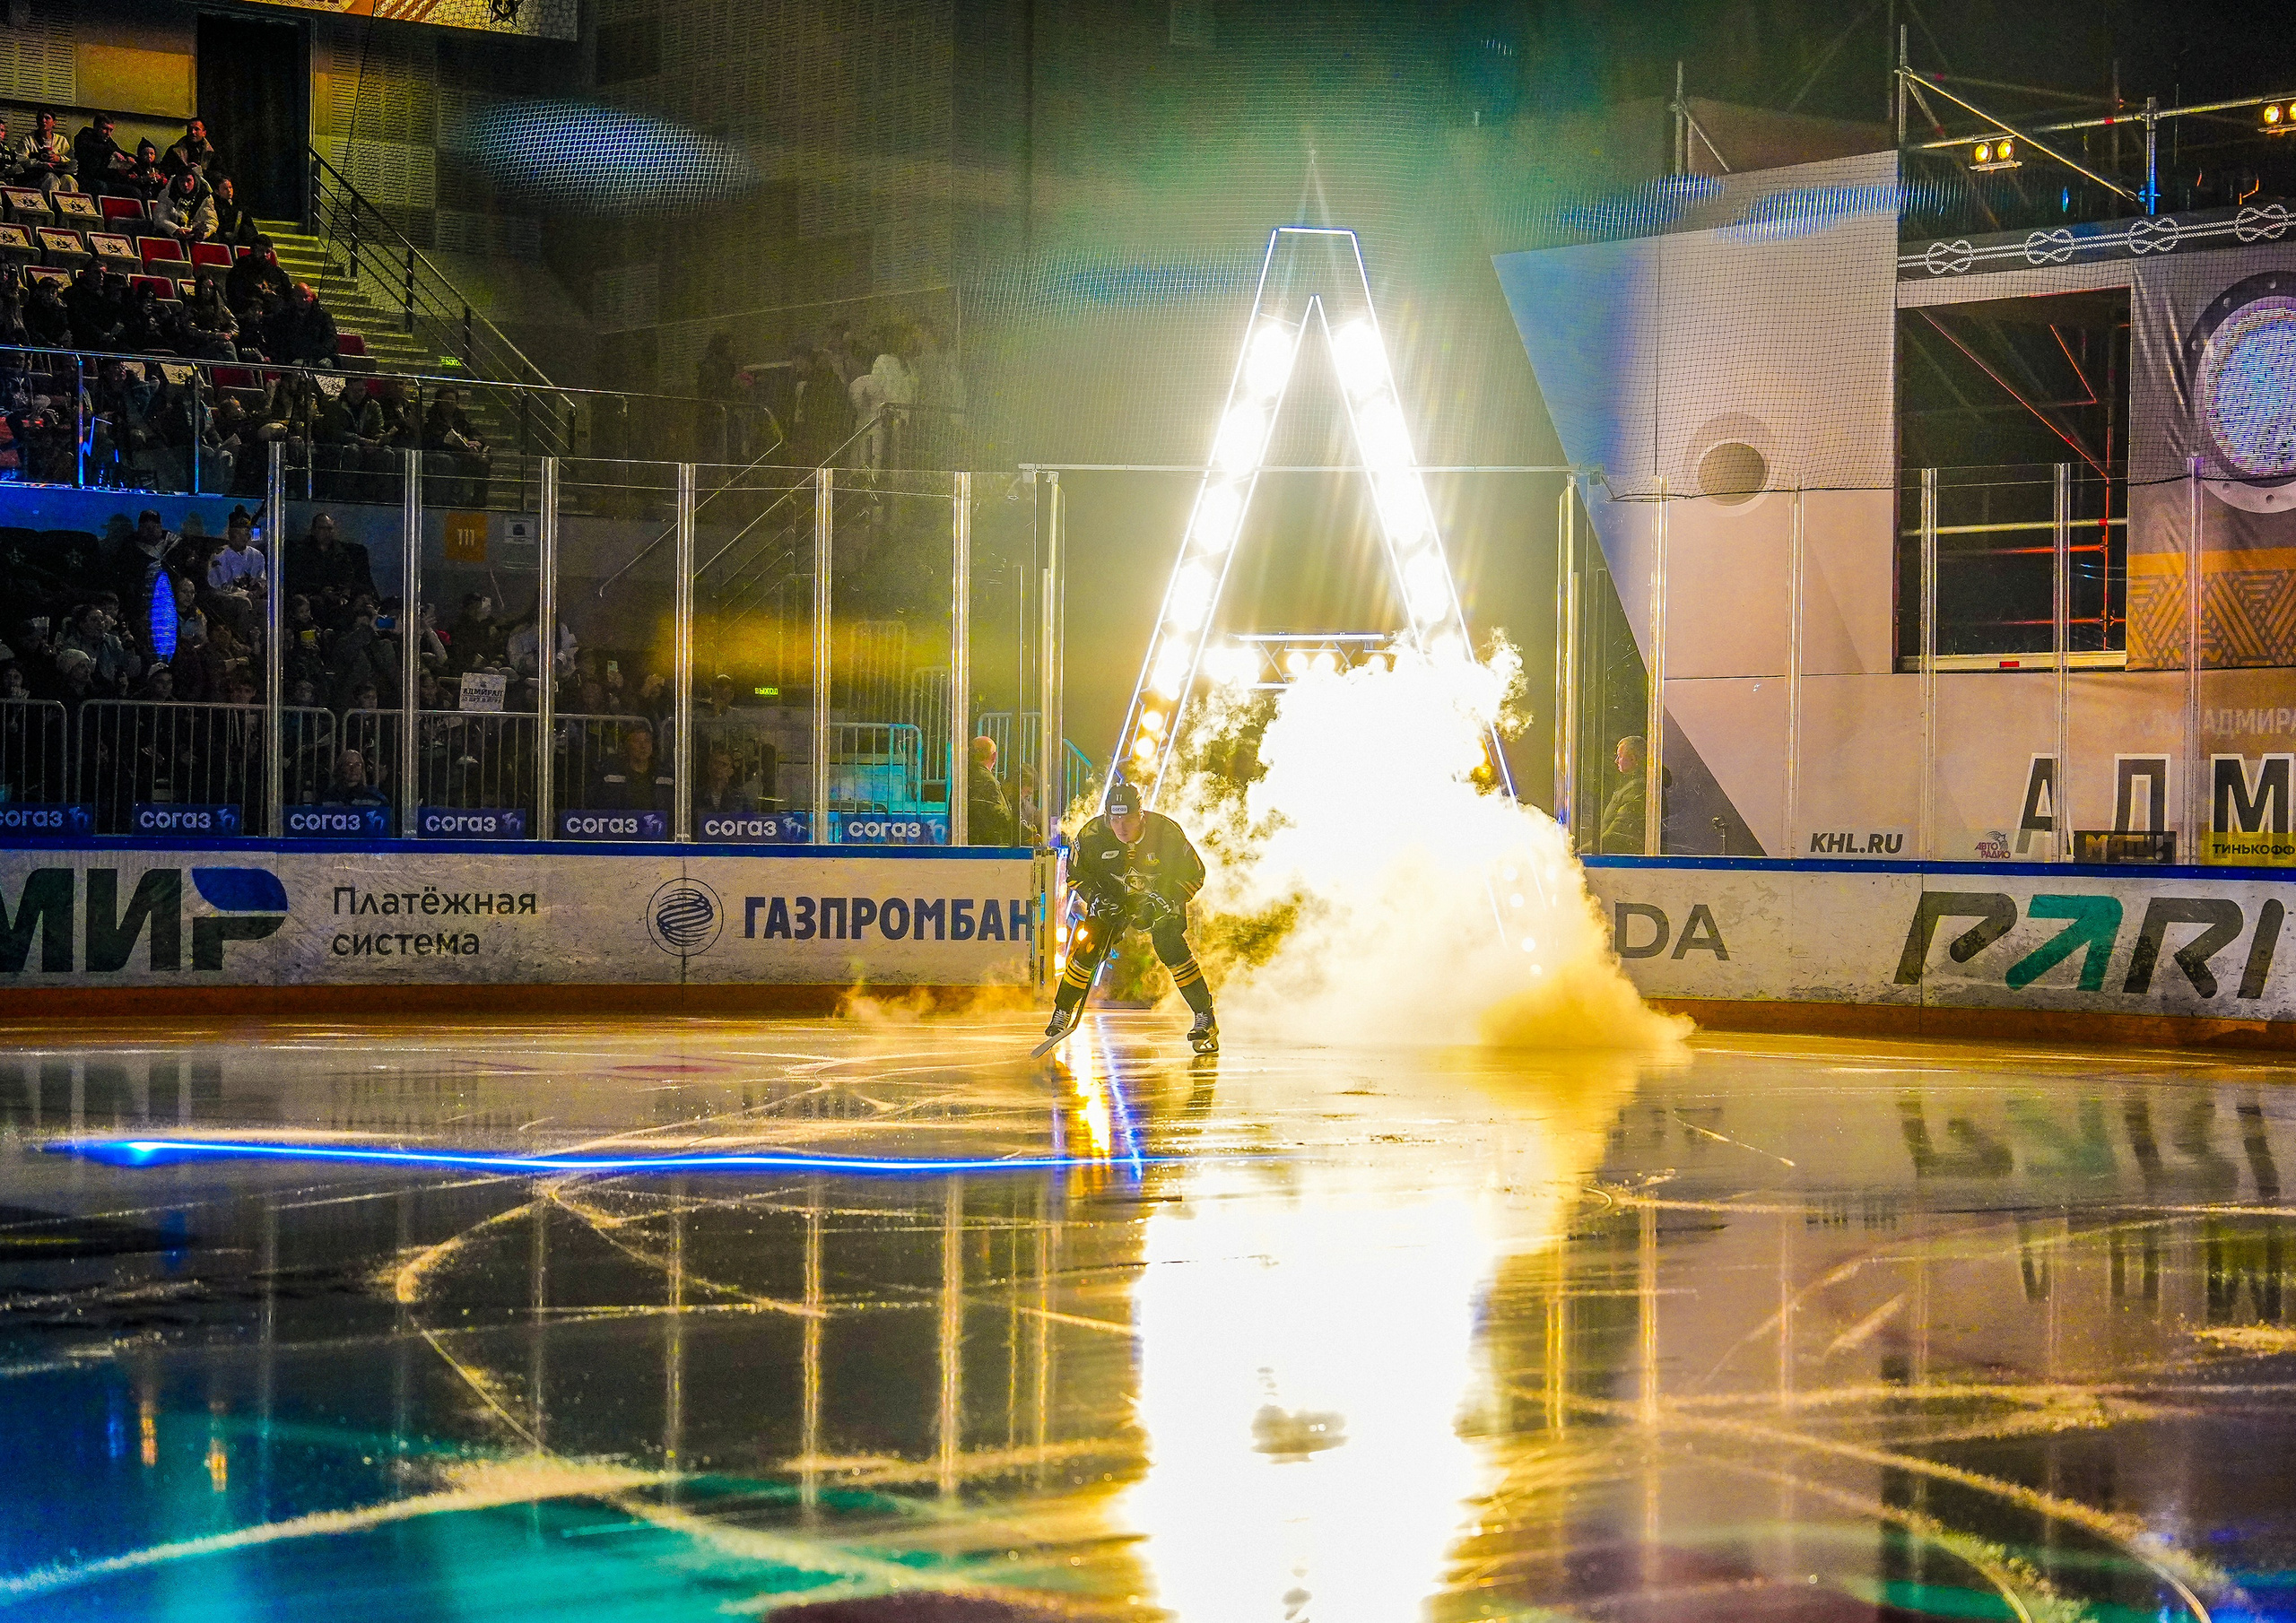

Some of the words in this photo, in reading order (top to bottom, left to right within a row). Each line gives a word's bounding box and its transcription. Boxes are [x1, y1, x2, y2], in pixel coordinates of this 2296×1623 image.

[457, 529, 475, 546] 111
[0, 811, 63, 828] огаз
[140, 812, 211, 829] согаз
[291, 812, 361, 831] согаз
[426, 815, 497, 832] согаз
[566, 817, 638, 834] согаз
[705, 820, 777, 837] согаз
[848, 820, 920, 838] согаз
[1810, 833, 1903, 854] KHL.RU
[1974, 842, 1998, 851] АВТО
[2212, 843, 2295, 855] ТИНЬКОФФ
[1981, 850, 2011, 859] РАДИО
[333, 885, 537, 916] Платёжная
[744, 896, 1033, 942] ГАЗПРОМБАН
[332, 932, 481, 957] система
[1892, 890, 2285, 1000] PARI
